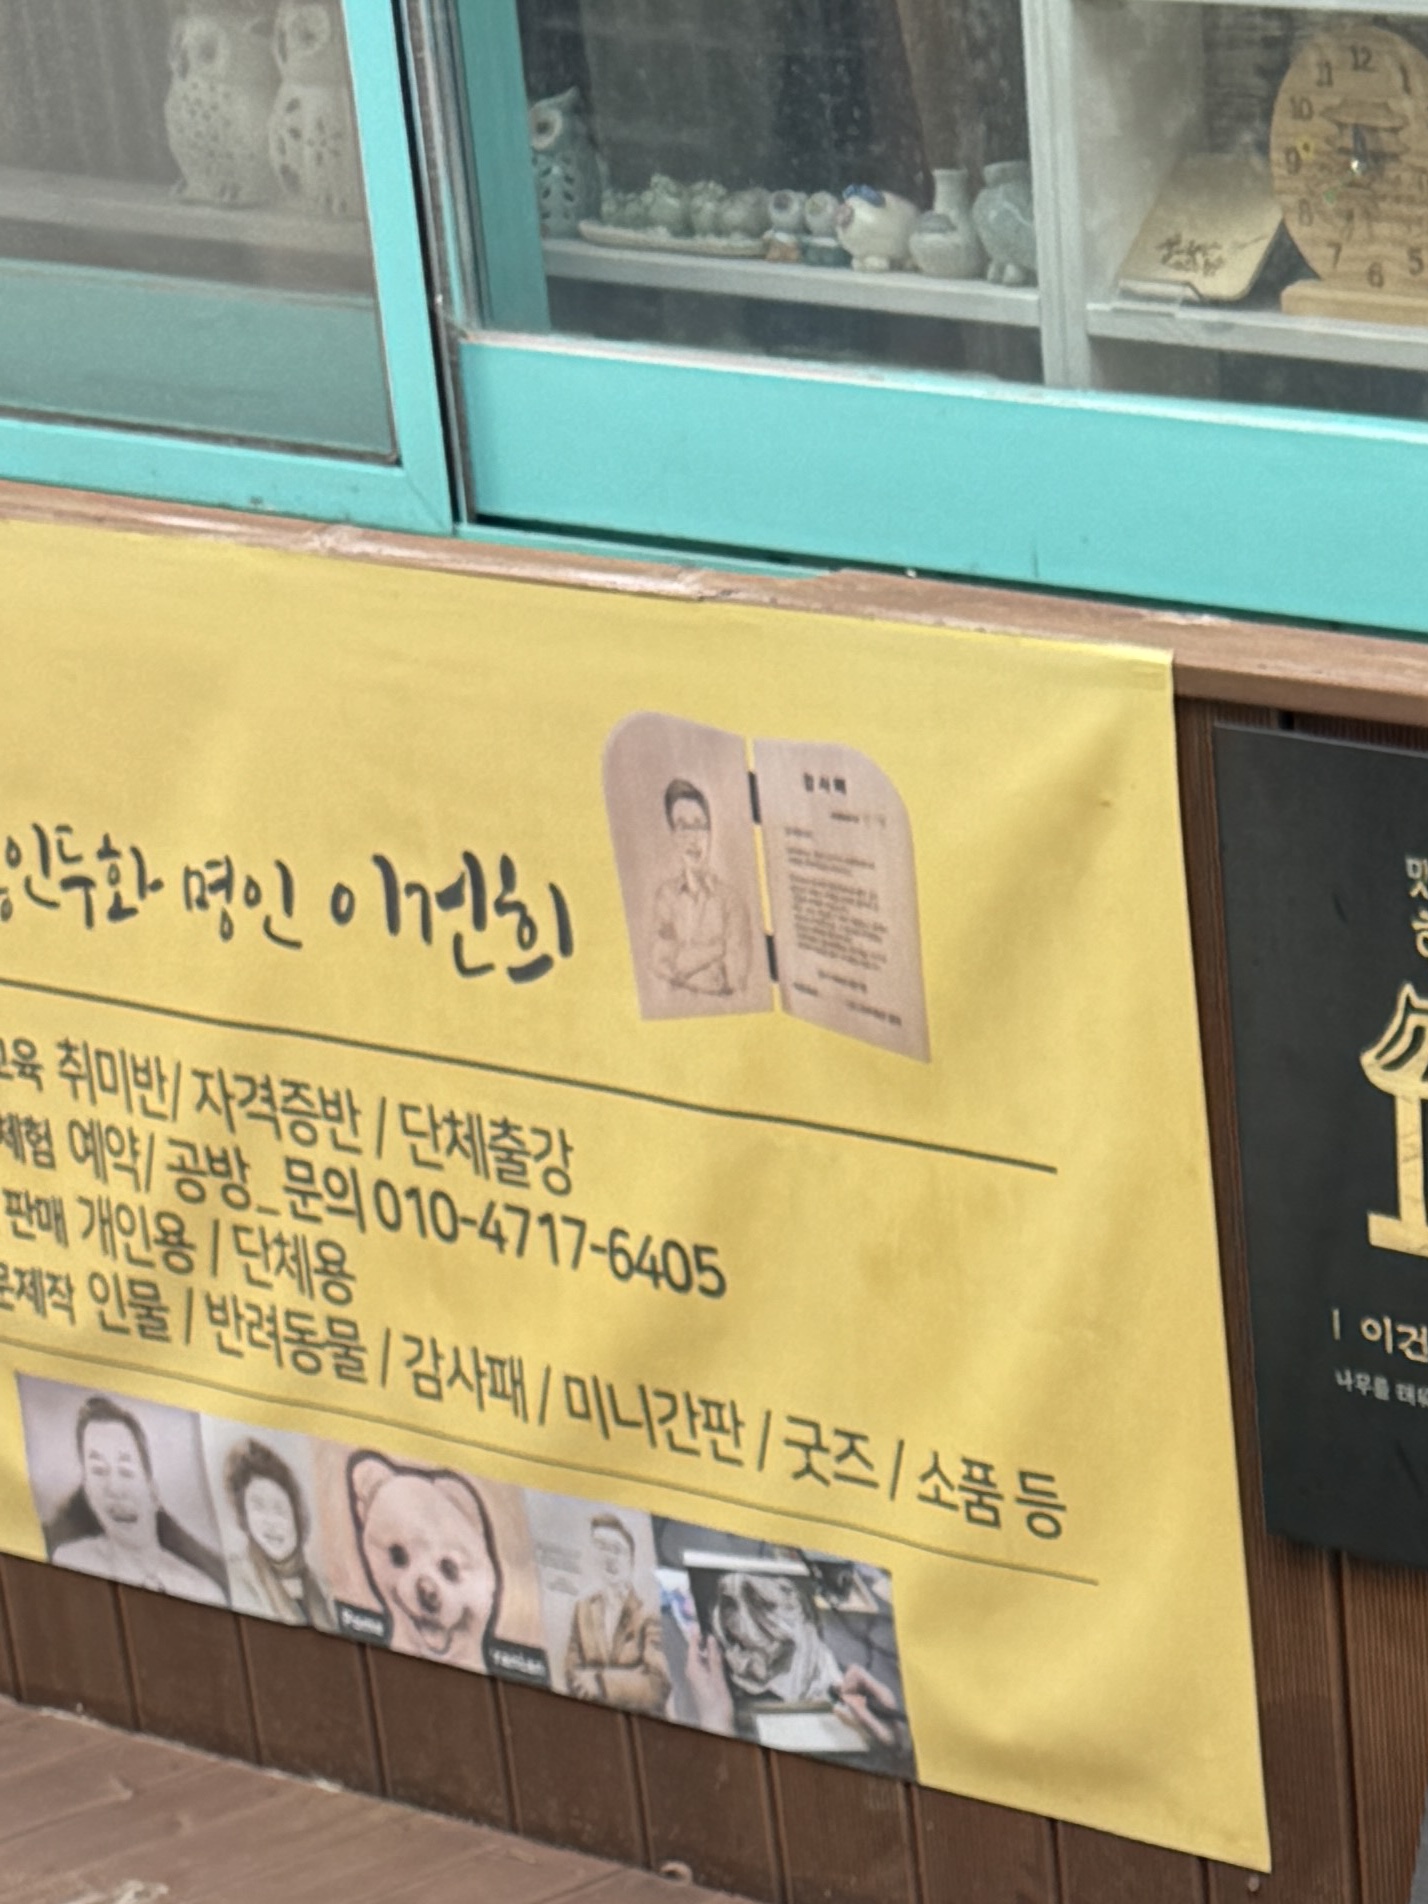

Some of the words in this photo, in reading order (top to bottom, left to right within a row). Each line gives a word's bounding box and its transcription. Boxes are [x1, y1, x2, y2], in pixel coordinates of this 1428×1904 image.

[1351, 47, 1373, 71] 12
[1327, 243, 1342, 269] 7
[1368, 262, 1384, 288] 6
[1408, 249, 1424, 275] 5
[0, 823, 164, 930] 인두화
[183, 854, 303, 951] 명인
[330, 850, 574, 984] 이건희
[191, 1066, 364, 1156] 자격증반
[398, 1101, 574, 1197] 단체출강
[2, 1187, 70, 1249] 판매
[76, 1194, 197, 1276] 개인용
[231, 1221, 357, 1307] 단체용
[87, 1270, 172, 1344] 인물
[206, 1291, 369, 1386] 반려동물
[401, 1331, 530, 1424] 감사패
[564, 1374, 746, 1468] 미니간판
[783, 1412, 881, 1489] 굿즈
[916, 1449, 1006, 1531] 소품
[1013, 1467, 1068, 1541] 등
